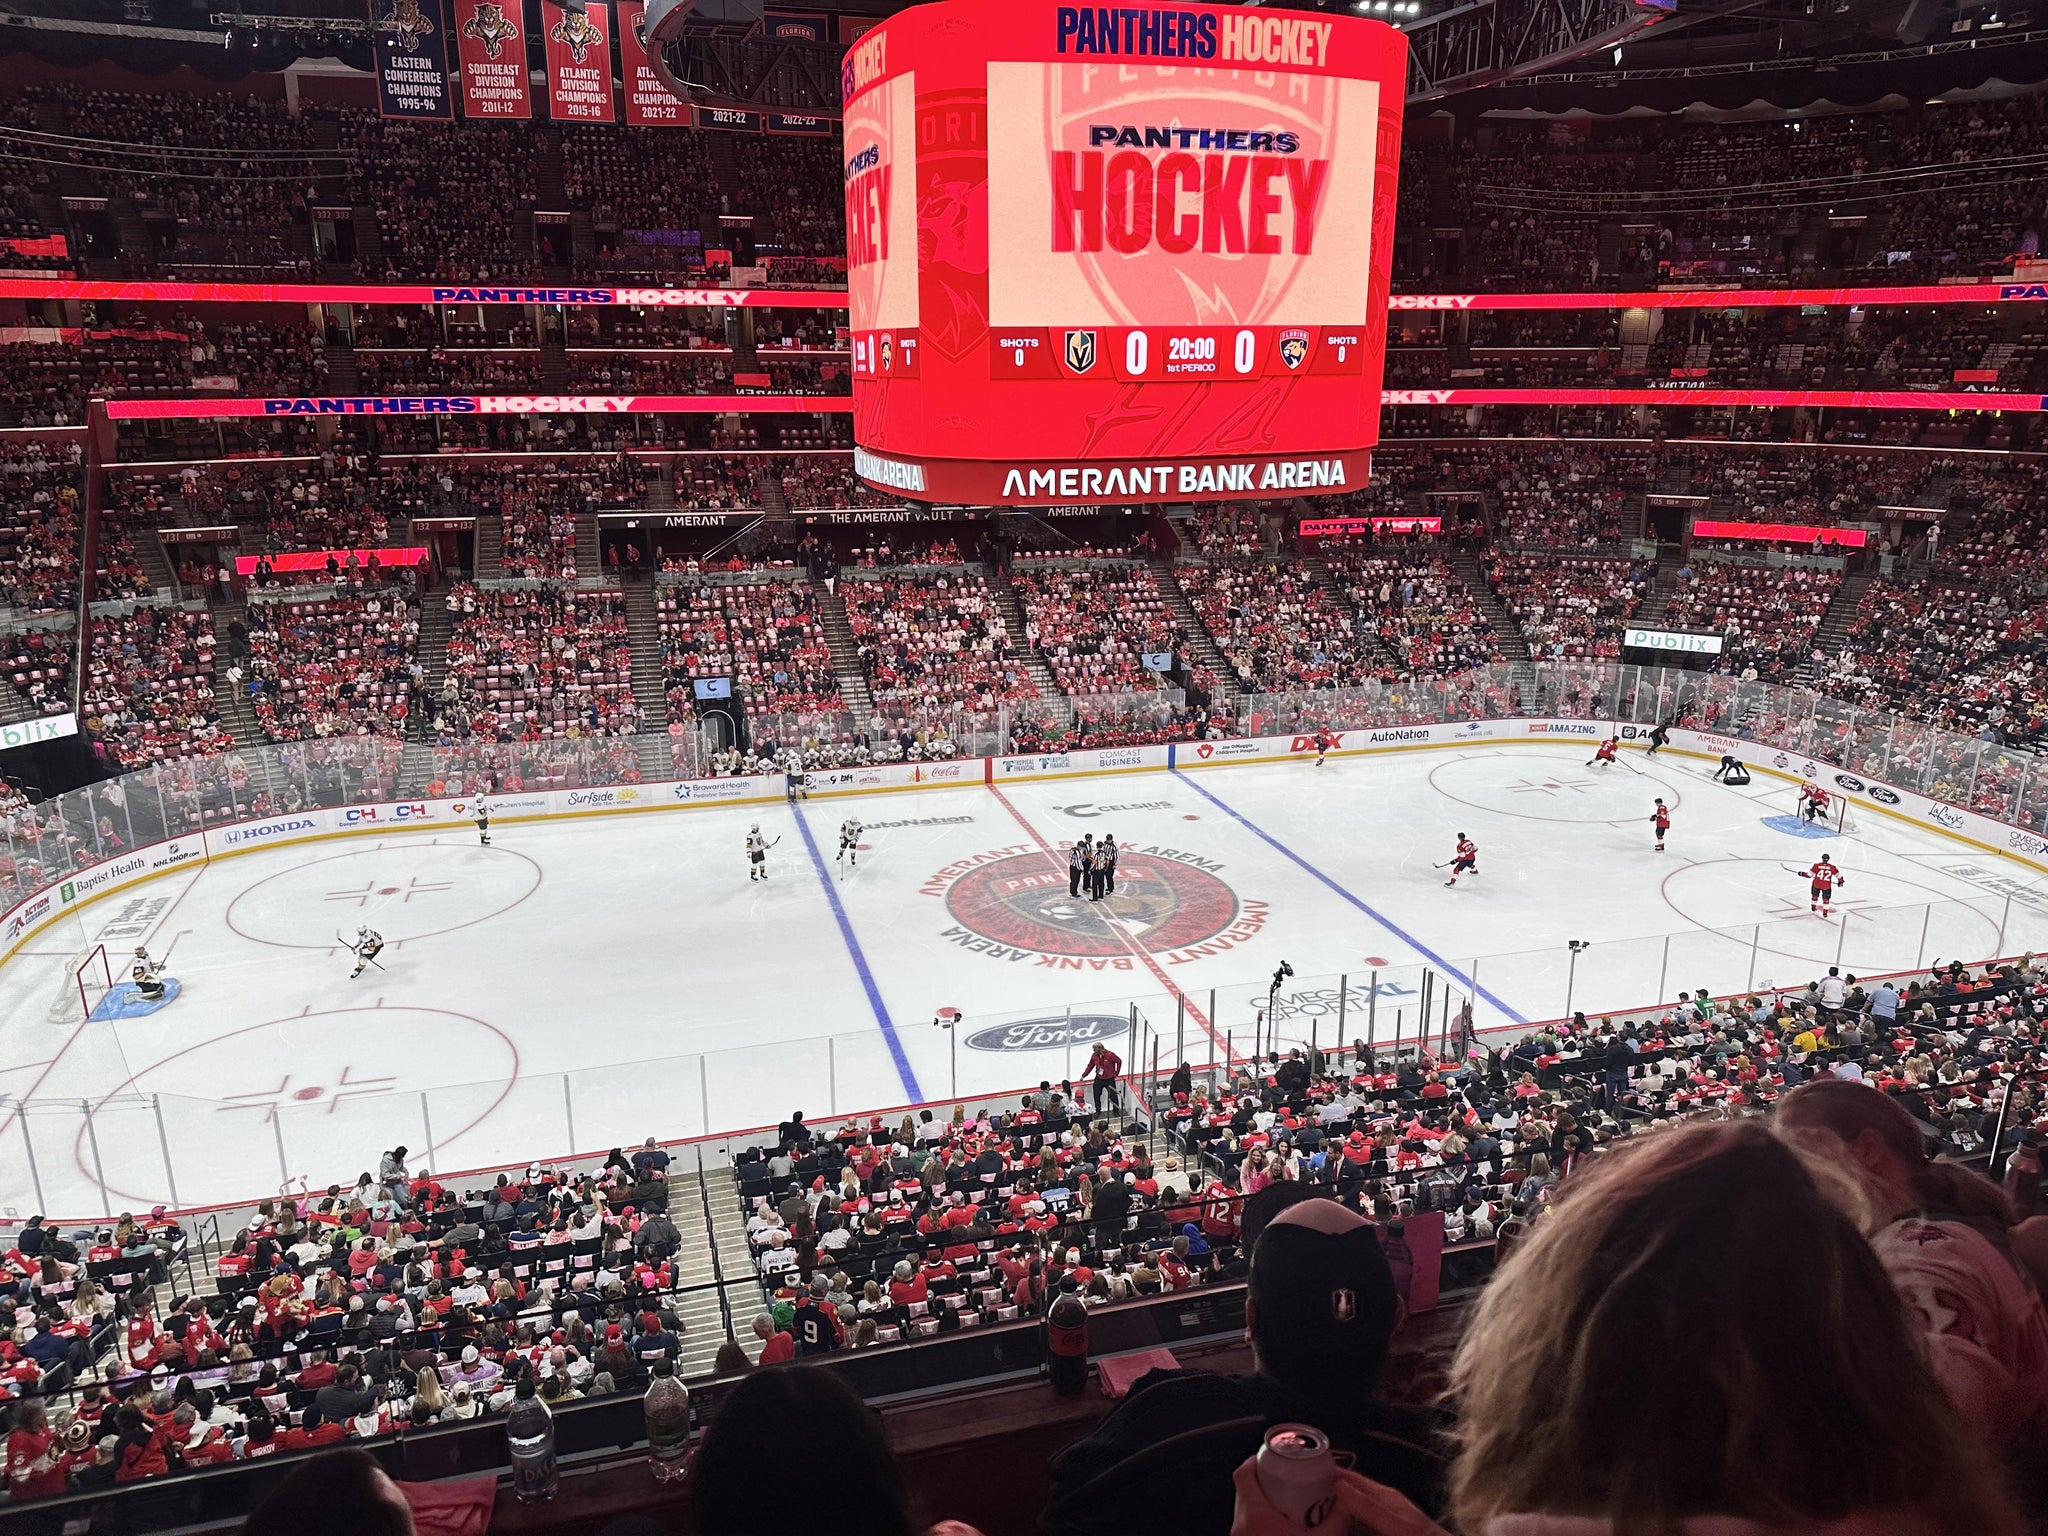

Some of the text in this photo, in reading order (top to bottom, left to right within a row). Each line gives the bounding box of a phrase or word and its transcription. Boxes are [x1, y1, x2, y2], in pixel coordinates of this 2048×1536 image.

[1057, 6, 1333, 67] PANTHERS HOCKEY
[391, 56, 433, 69] EASTERN
[468, 63, 520, 76] SOUTHEAST
[384, 69, 442, 84] CONFERENCE
[559, 67, 601, 80] ATLANTIC
[475, 75, 515, 88] DIVISION
[561, 78, 600, 92] DIVISION
[387, 83, 442, 97] CHAMPIONS
[469, 87, 523, 100] CHAMPIONS
[556, 90, 607, 104] CHAMPIONS
[397, 97, 436, 111] 1995-96
[482, 101, 514, 113] 2011-12
[567, 104, 601, 117] 2015-16
[642, 106, 677, 119] 2021-22
[712, 110, 746, 124] 2021-22
[1090, 124, 1300, 154] PANTHERS
[1051, 150, 1328, 256] HOCKEY
[432, 288, 750, 304] PANTHERS HOCKEY
[999, 338, 1039, 348] SHOTS
[1327, 336, 1358, 345] SHOTS
[1126, 330, 1168, 376] 0
[1169, 337, 1216, 360] 20:00
[1234, 329, 1255, 374] 0
[1338, 345, 1346, 363] 0
[1015, 348, 1024, 367] 0
[1166, 363, 1216, 372] 1st PERIOD
[264, 396, 636, 414] PANTHERS HOCKEY
[883, 457, 926, 491] ARENA
[1003, 459, 1347, 497] AMERANT BANK ARENA
[1650, 498, 1703, 508] 105 107
[830, 510, 954, 523] THE AMERANT VAULT
[1047, 506, 1101, 517] AMERANT
[1885, 510, 1937, 521] 107 108
[416, 521, 473, 531] 132 133
[665, 515, 727, 527] AMERANT
[166, 531, 232, 542] 131 132
[1370, 730, 1429, 742] AutoNation
[1548, 724, 1596, 735] AMAZING
[1697, 735, 1740, 748] AMERANT
[1099, 749, 1141, 759] COMCAST
[1707, 745, 1727, 755] BANK
[1099, 757, 1142, 767] BUSINESS
[693, 781, 750, 792] Broward Health
[1839, 777, 1860, 791] Ford
[568, 791, 614, 806] Surfside
[1873, 788, 1894, 803] Ford
[1098, 800, 1175, 813] CELSIUS
[243, 819, 316, 839] HONDA
[2009, 831, 2041, 847] OMEGA
[2008, 839, 2040, 856] SPORT
[1142, 846, 1226, 873] ARENA
[76, 858, 145, 893] Baptist Health
[1816, 869, 1832, 882] 42
[24, 896, 50, 918] ACTION
[940, 925, 1033, 963] ARENA
[1033, 954, 1134, 971] BANK
[1003, 1018, 1100, 1047] Ford
[1208, 1202, 1230, 1223] 12
[804, 1319, 818, 1344] 9
[250, 1443, 275, 1458] BARKOV
